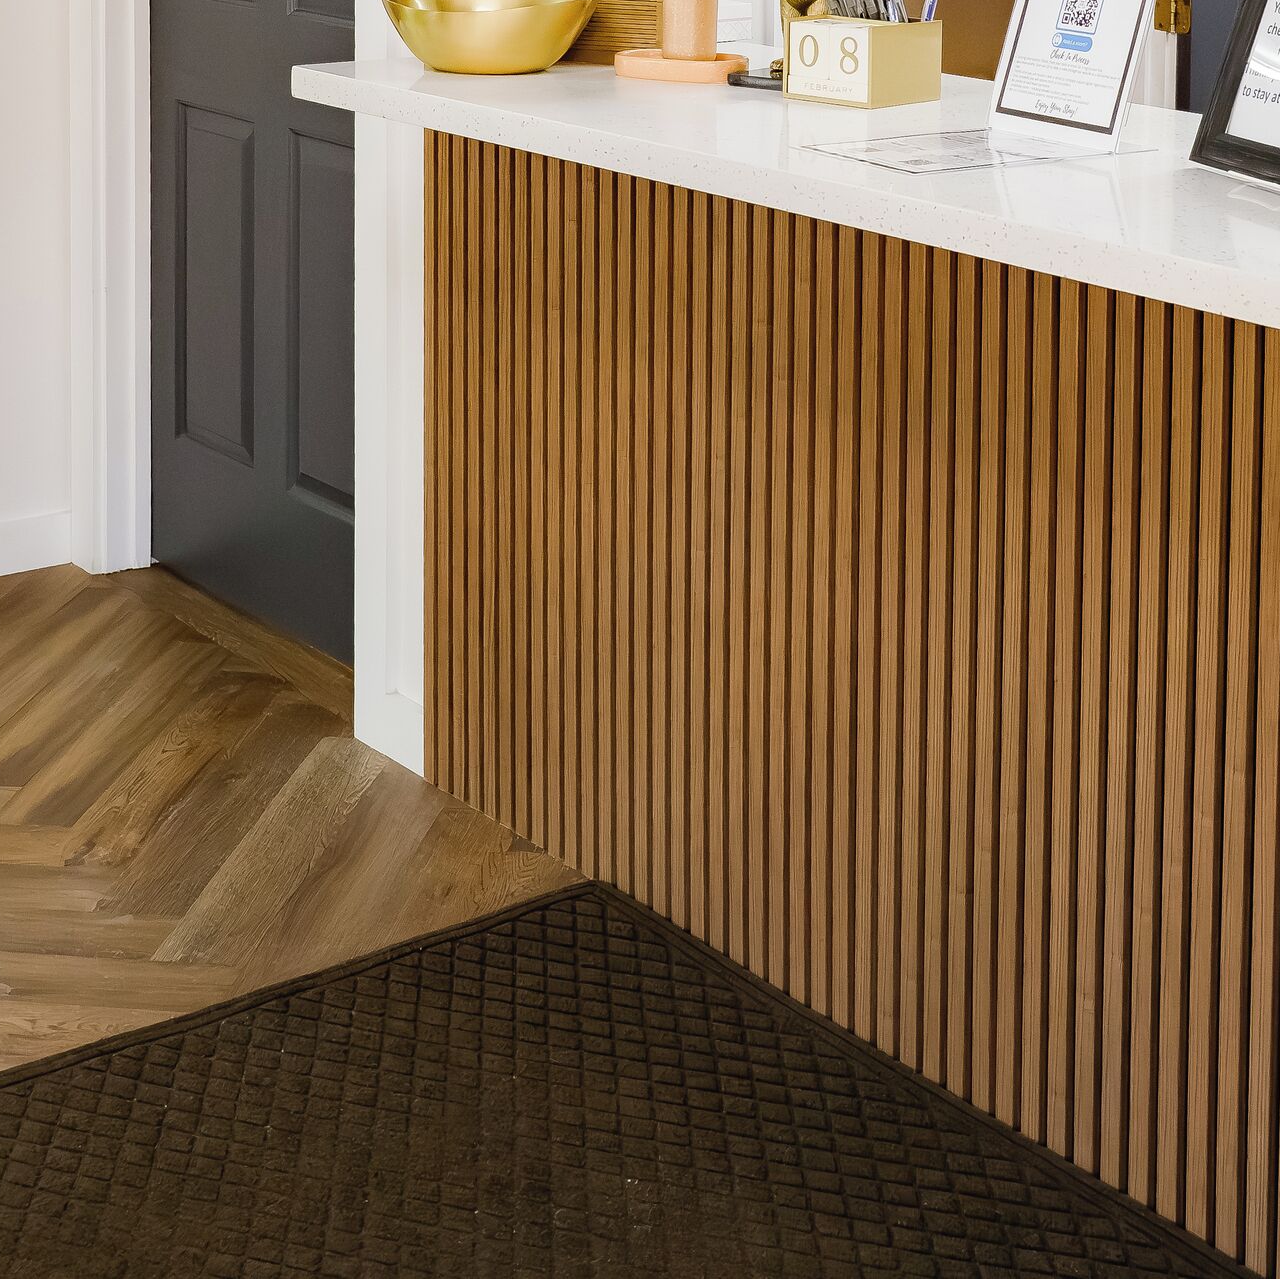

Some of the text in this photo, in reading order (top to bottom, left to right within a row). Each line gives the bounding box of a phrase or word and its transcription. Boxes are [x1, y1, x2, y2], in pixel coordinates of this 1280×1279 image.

[804, 82, 853, 94] FEBRUARY
[1242, 84, 1251, 97] to
[1252, 88, 1270, 104] stay
[1271, 92, 1280, 104] at
[1035, 99, 1049, 113] Enjoy
[1050, 101, 1061, 113] Your
